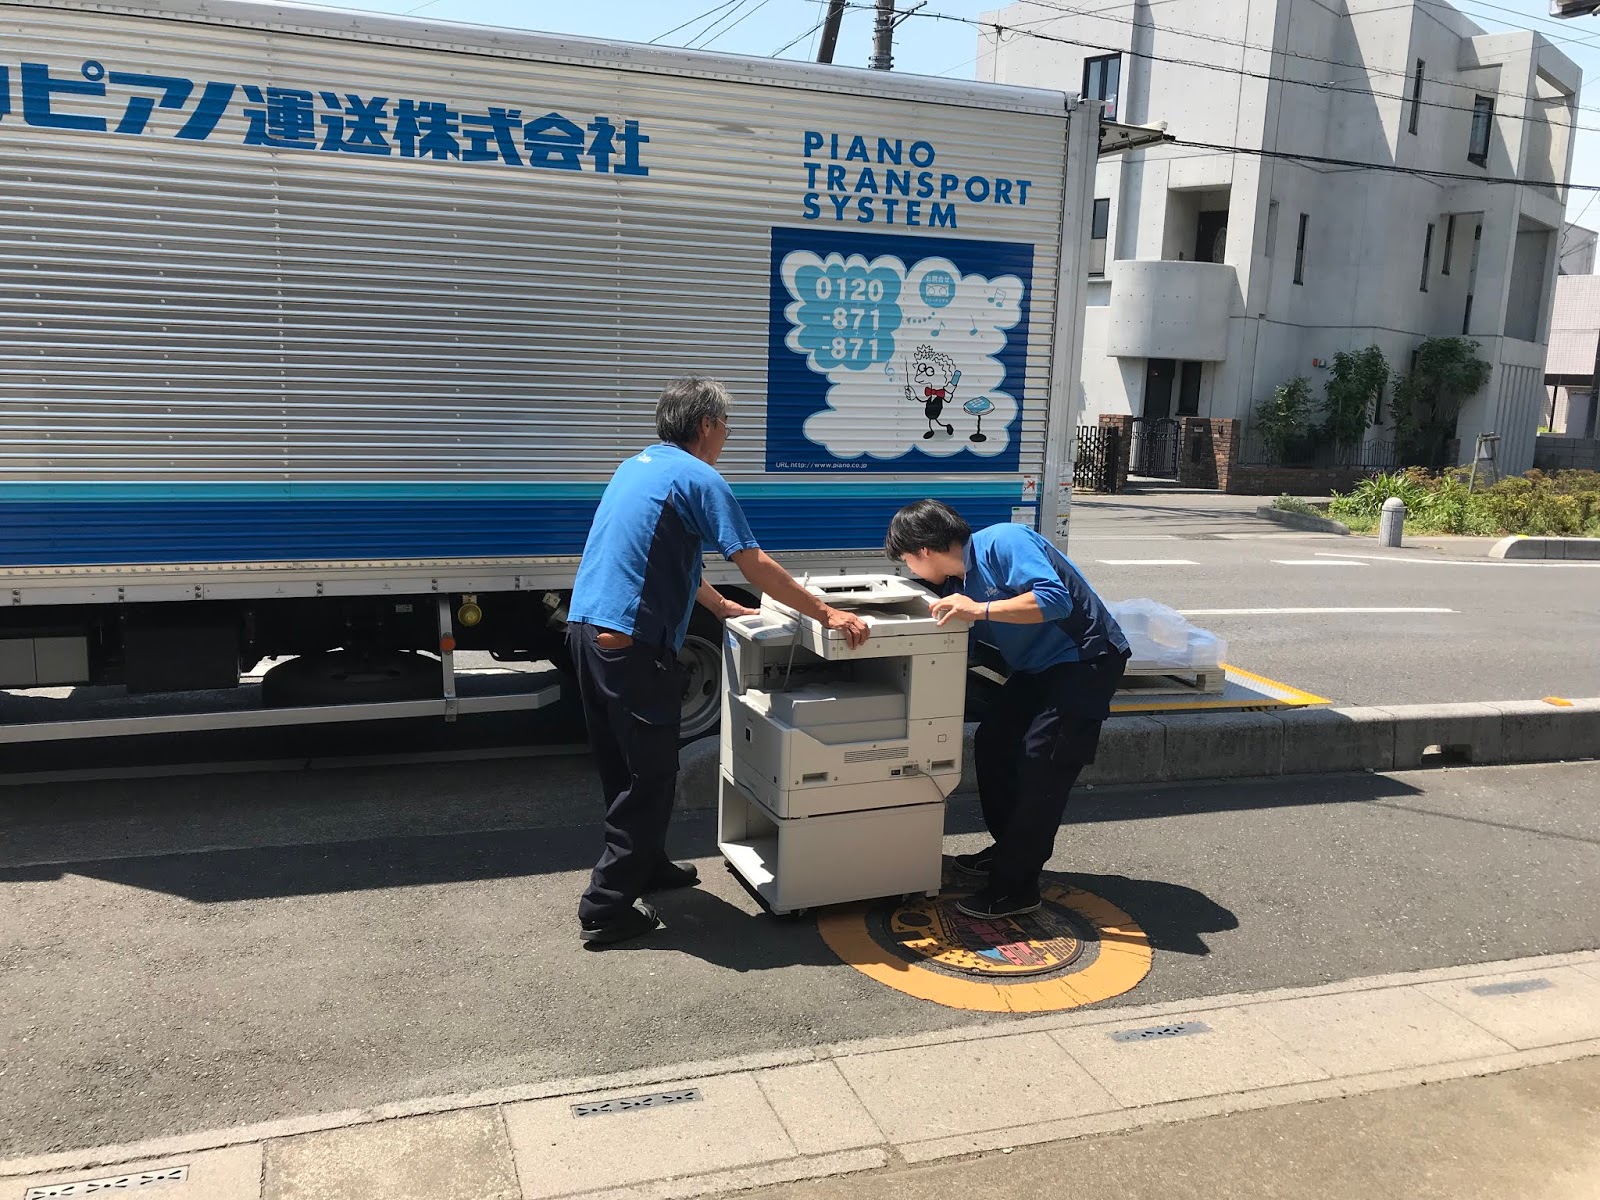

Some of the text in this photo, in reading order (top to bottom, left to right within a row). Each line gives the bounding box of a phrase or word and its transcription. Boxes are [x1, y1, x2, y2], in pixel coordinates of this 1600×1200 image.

[0, 60, 650, 176] ピアノ運送株式会社
[804, 131, 935, 167] PIANO
[804, 162, 1032, 205] TRANSPORT
[803, 194, 957, 228] SYSTEM
[816, 276, 884, 302] 0120
[822, 307, 880, 331] -871
[821, 337, 878, 360] -871
